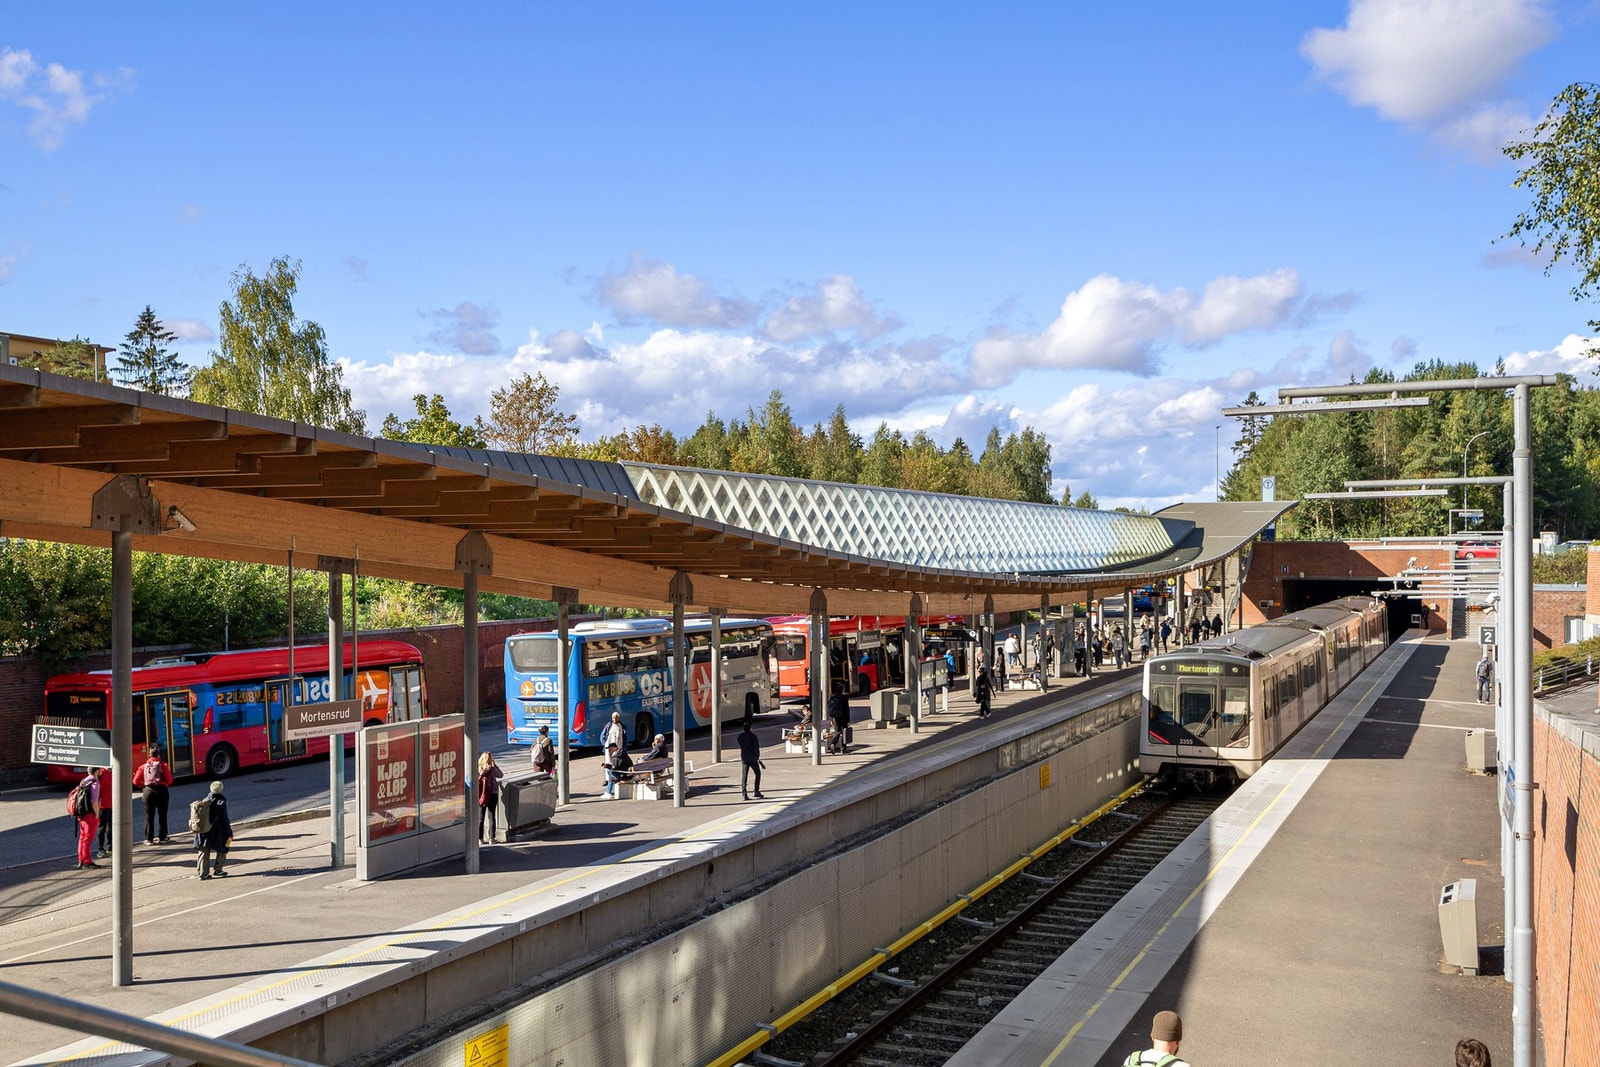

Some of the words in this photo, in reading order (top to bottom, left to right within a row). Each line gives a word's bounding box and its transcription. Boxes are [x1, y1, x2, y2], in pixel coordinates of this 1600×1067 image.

[1484, 631, 1492, 643] 2
[535, 681, 558, 693] OSL
[588, 680, 636, 700] FLYBUSS
[641, 671, 672, 696] OSL
[300, 707, 350, 724] Mortensrud
[524, 705, 559, 714] FLYBUSS
[49, 729, 66, 738] T-bane,
[79, 731, 84, 745] 1
[48, 747, 80, 755] Bussterminal
[430, 751, 456, 771] KJØP
[378, 761, 407, 782] KJØP
[429, 772, 437, 788] &
[437, 768, 456, 786] LØP
[377, 783, 386, 800] &
[386, 778, 407, 797] LØP
